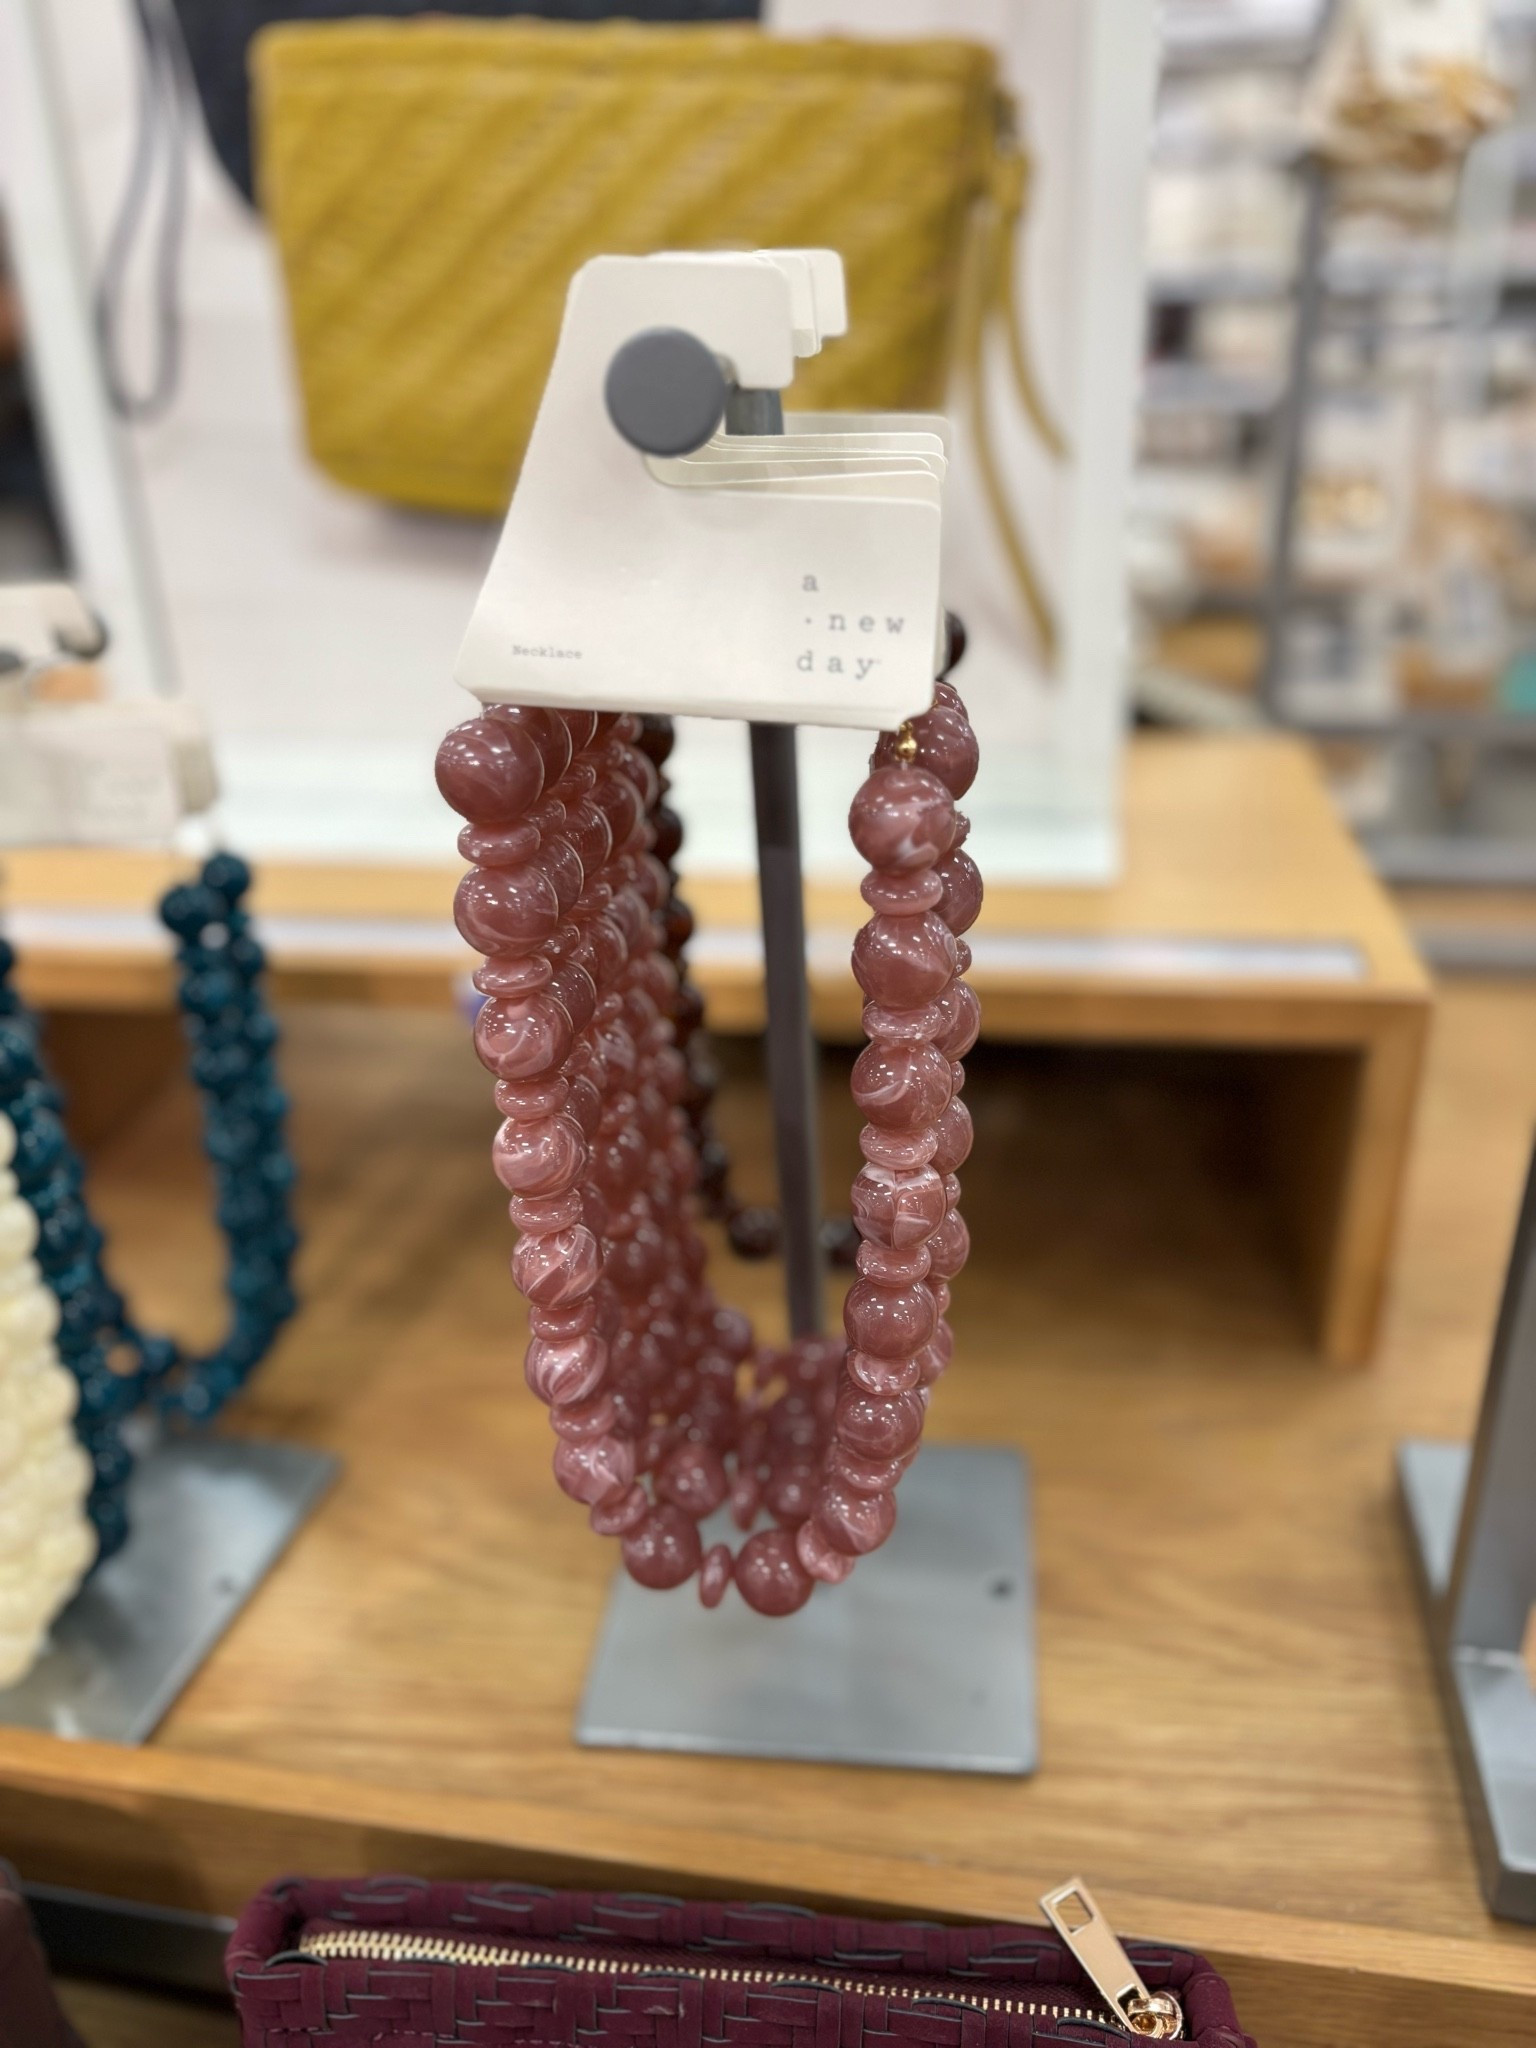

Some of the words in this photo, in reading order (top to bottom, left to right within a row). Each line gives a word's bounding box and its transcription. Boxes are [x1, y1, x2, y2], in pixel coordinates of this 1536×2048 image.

[802, 574, 818, 592] a
[512, 644, 583, 660] Necklace
[797, 648, 875, 680] day
